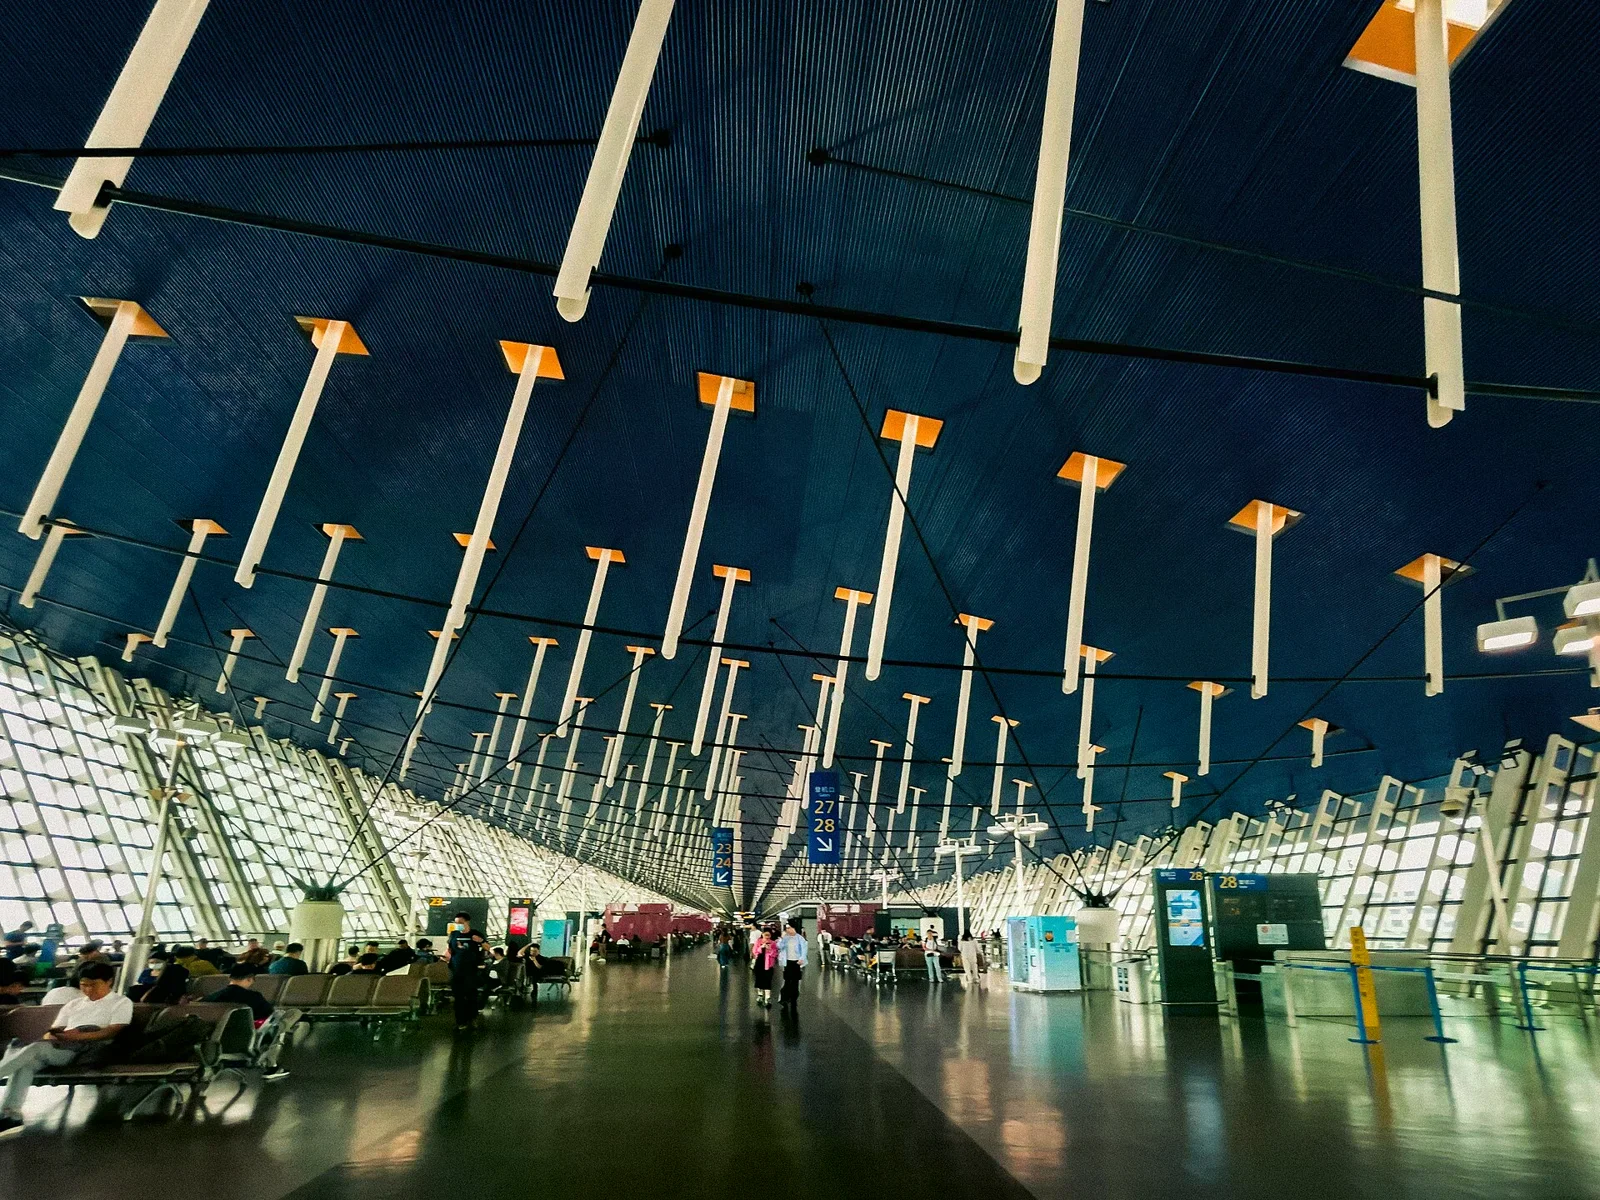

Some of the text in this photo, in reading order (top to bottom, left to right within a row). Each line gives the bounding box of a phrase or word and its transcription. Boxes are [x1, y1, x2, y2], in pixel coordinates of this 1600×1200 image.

[814, 800, 835, 814] 27
[813, 818, 835, 833] 28
[716, 843, 732, 854] 23
[715, 857, 732, 868] 24
[1189, 871, 1203, 881] 28
[1218, 875, 1238, 889] 28
[429, 897, 443, 906] 23
